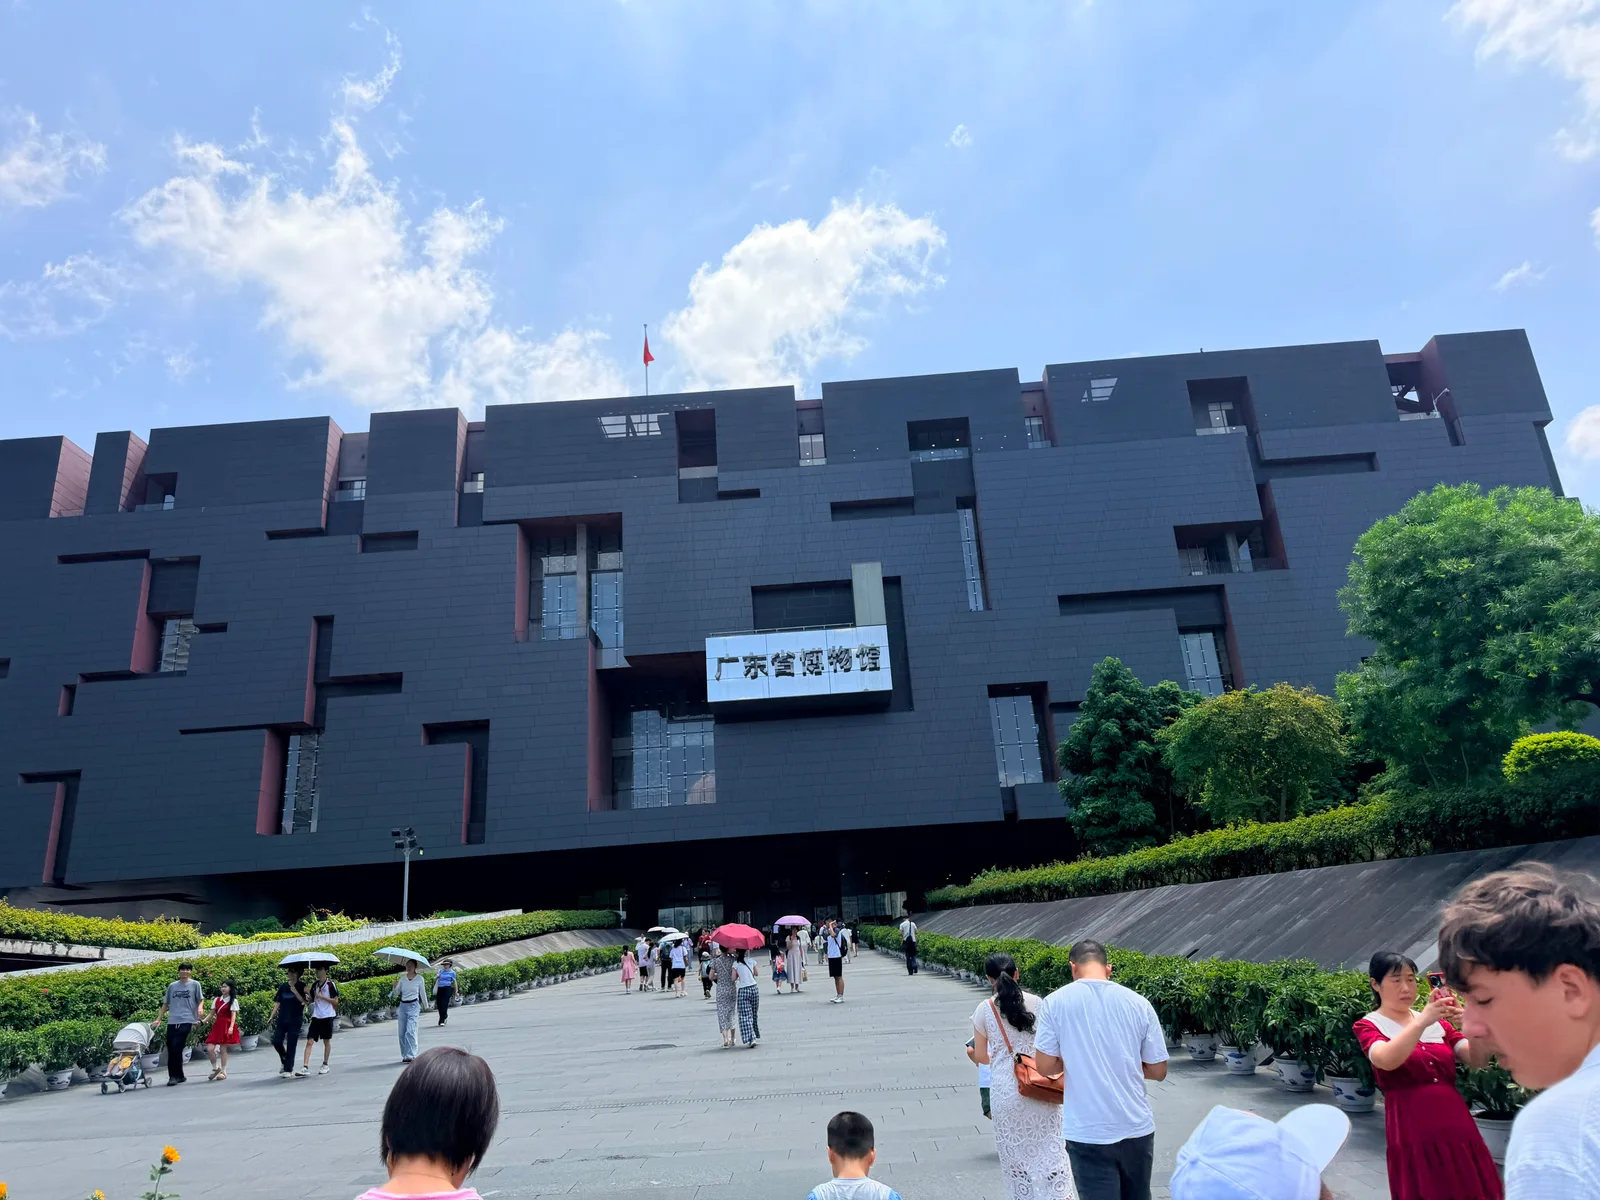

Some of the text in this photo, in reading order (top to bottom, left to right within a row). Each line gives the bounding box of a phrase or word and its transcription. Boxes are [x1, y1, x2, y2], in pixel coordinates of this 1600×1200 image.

[715, 643, 881, 681] 广东省博物馆
